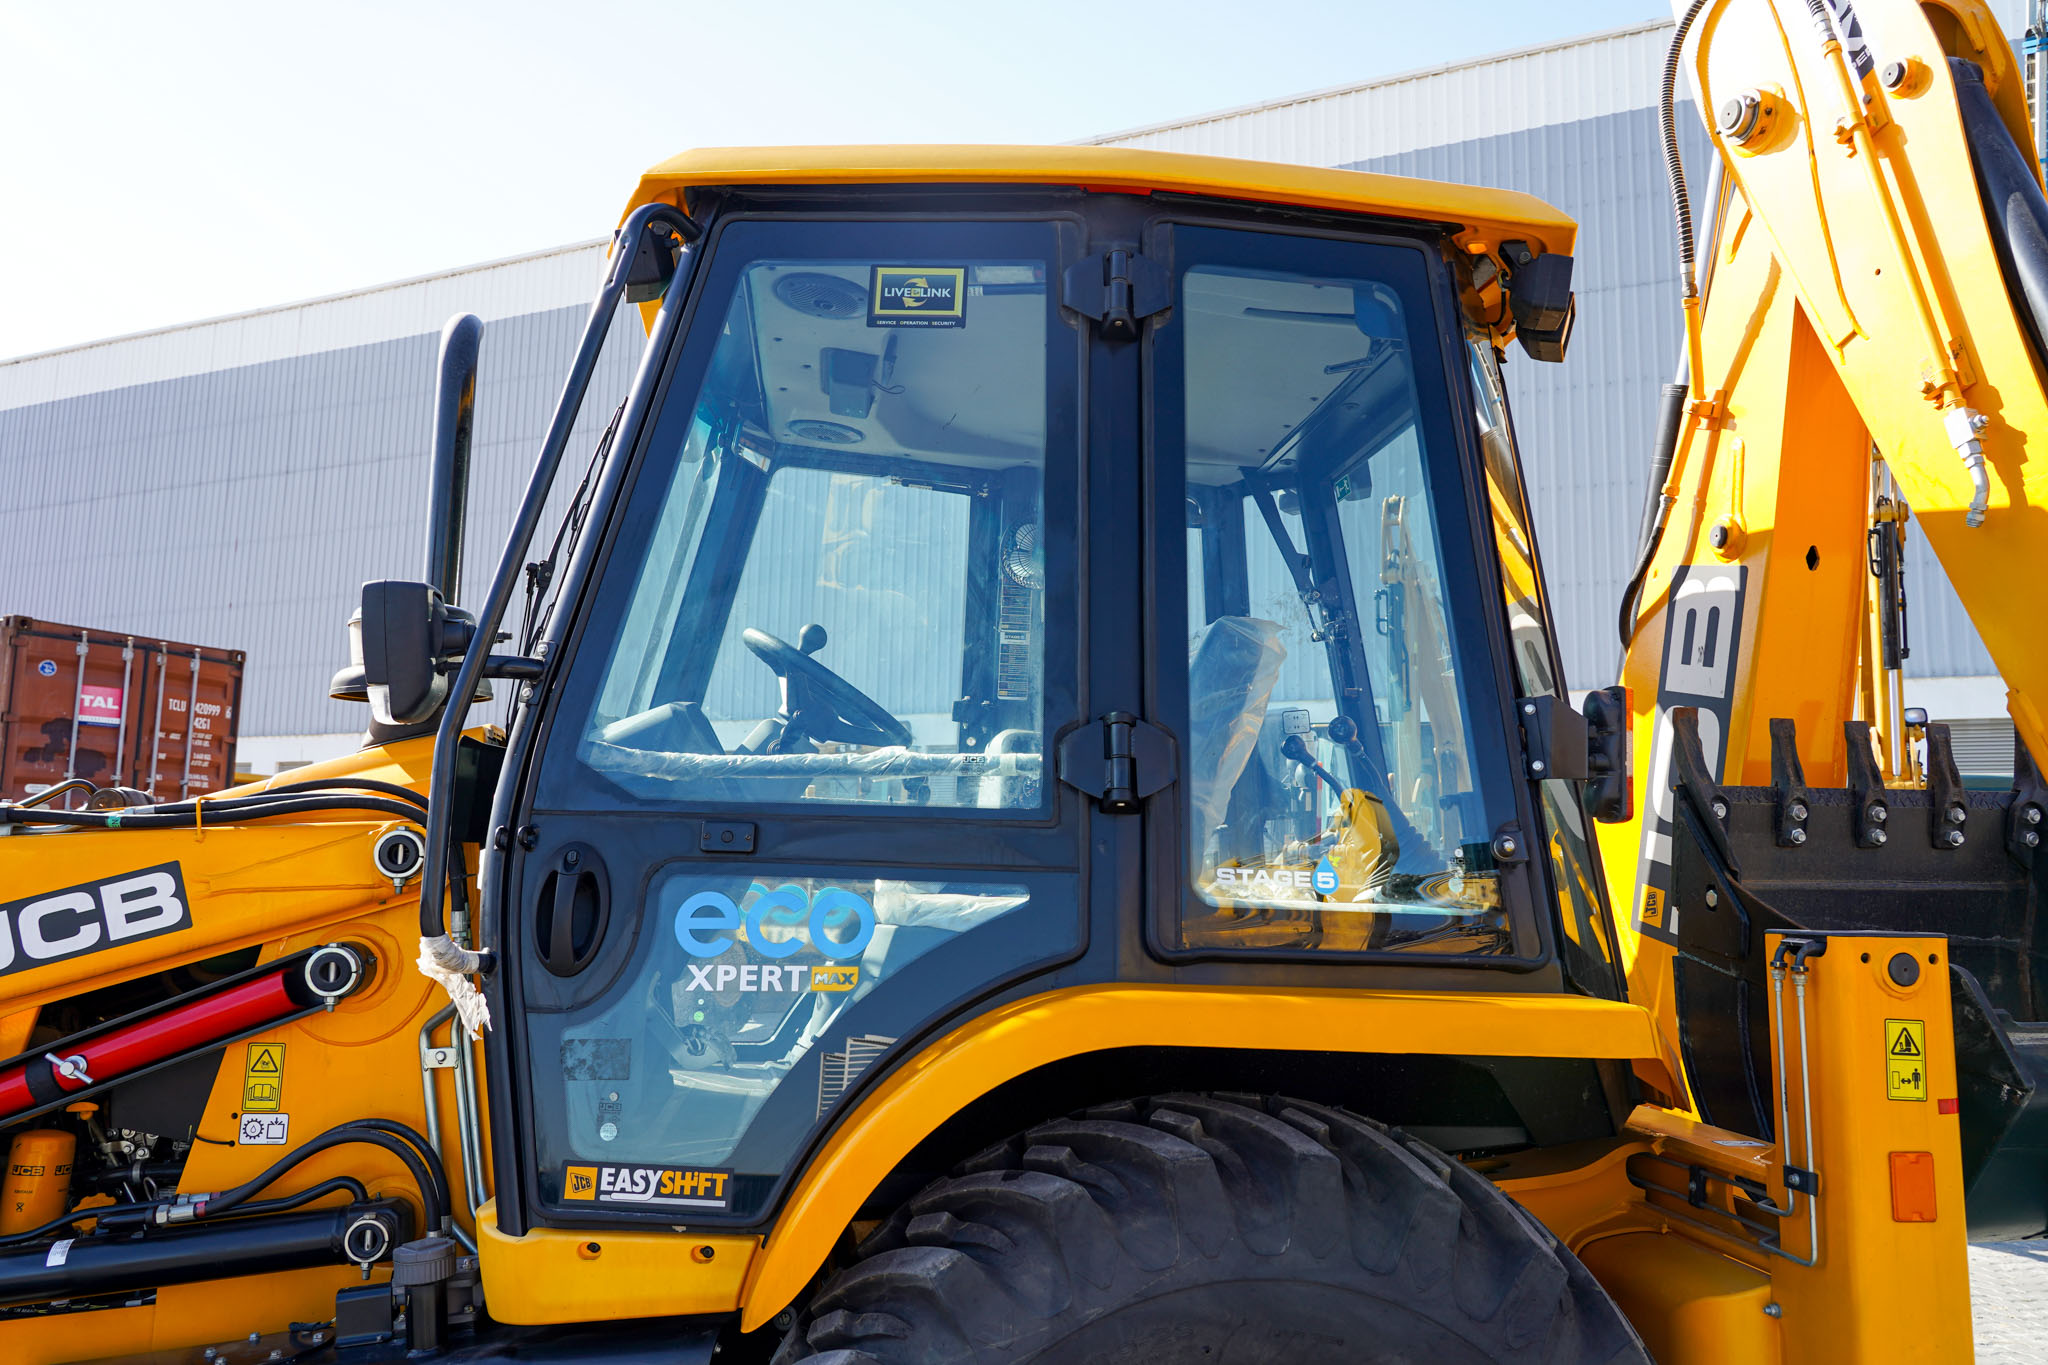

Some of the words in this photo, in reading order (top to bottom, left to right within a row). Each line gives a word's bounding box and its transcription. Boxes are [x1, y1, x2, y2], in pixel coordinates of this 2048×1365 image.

[81, 694, 119, 710] TAL
[168, 698, 187, 712] TCLU
[225, 706, 232, 719] 6
[1216, 868, 1312, 888] STAGE
[1317, 871, 1335, 889] 5
[1644, 891, 1657, 917] JCB
[0, 872, 183, 971] CB
[674, 891, 876, 959] eco
[685, 964, 808, 992] XPERT
[814, 972, 856, 986] MAX
[13, 1165, 44, 1176] JCB
[56, 1165, 72, 1175] JC
[572, 1174, 592, 1192] JCB
